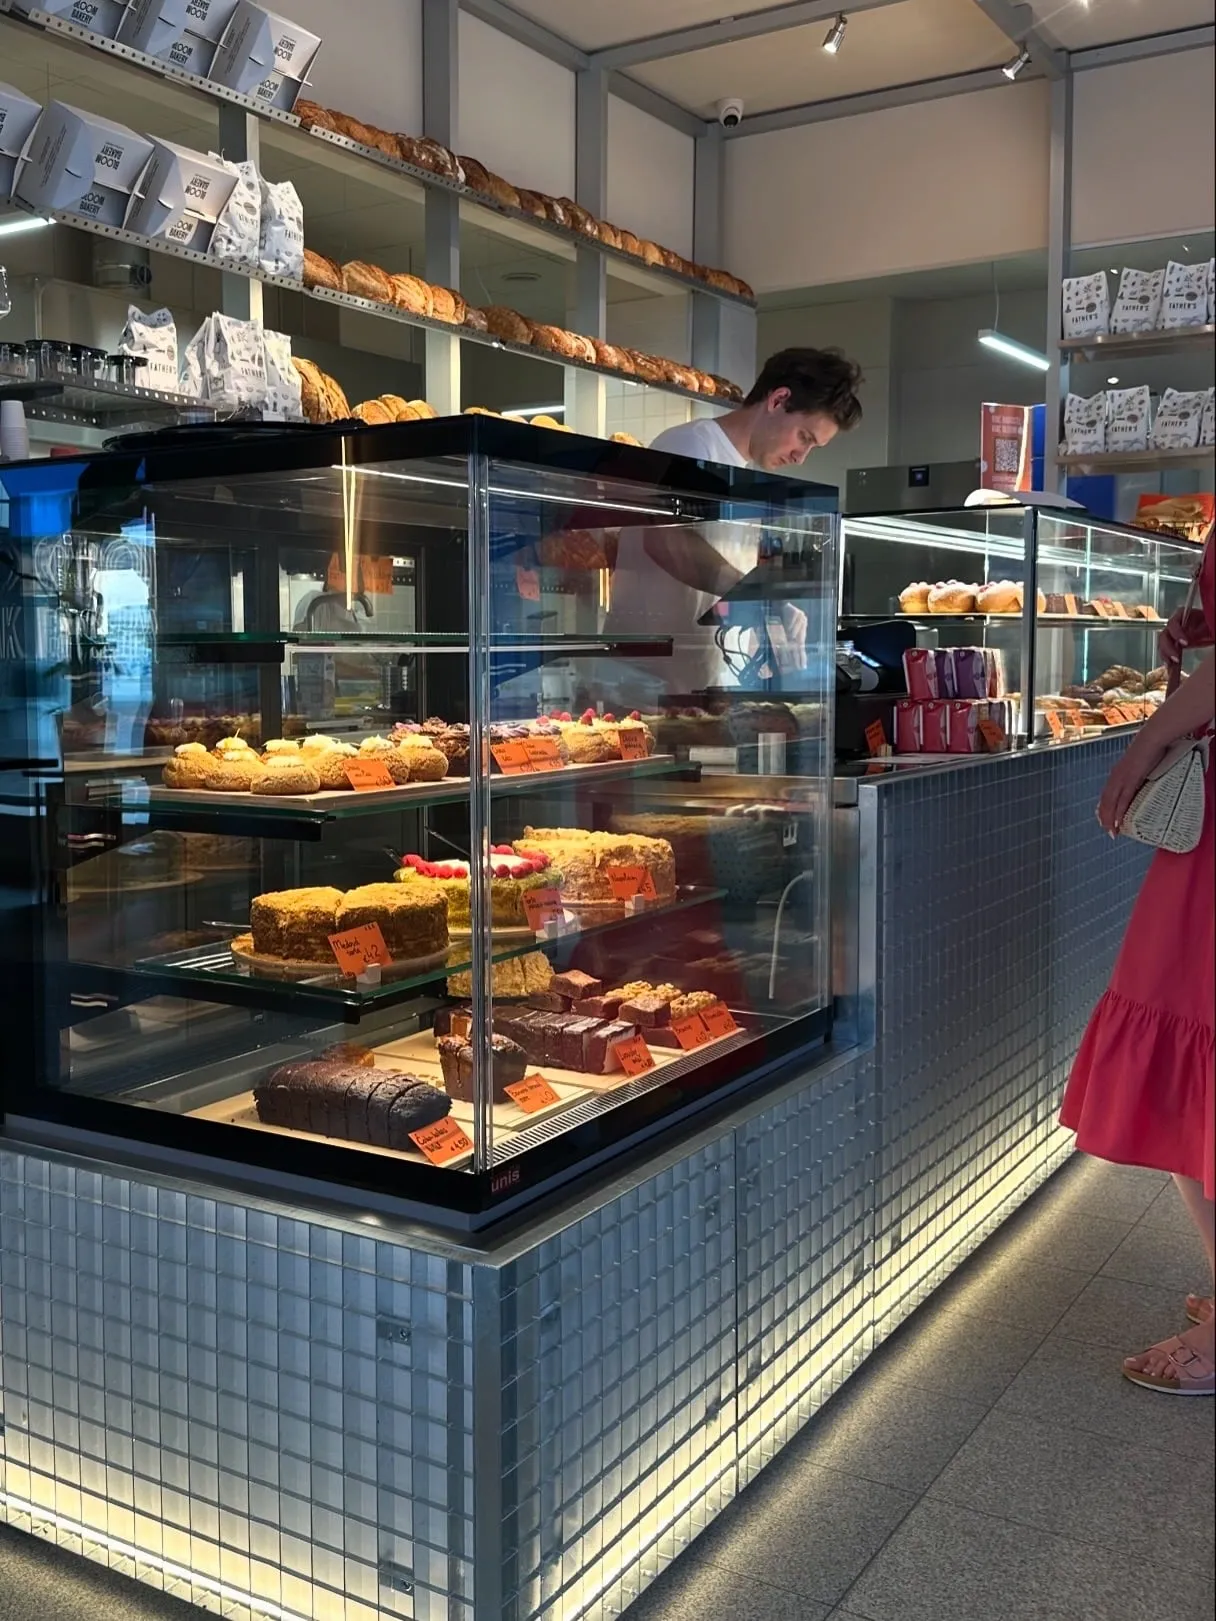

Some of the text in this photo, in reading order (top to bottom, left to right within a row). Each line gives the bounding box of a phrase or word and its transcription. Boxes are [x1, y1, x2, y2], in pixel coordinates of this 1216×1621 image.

[71, 10, 93, 24] BAKERY
[169, 50, 188, 64] BAKERY
[101, 145, 123, 160] BAKERY
[95, 154, 120, 170] BLOOM
[190, 177, 210, 190] BAKERY
[184, 185, 207, 200] BLOOM
[79, 201, 101, 215] BAKERY
[169, 228, 188, 240] BAKERY
[1072, 313, 1098, 324] FATHER'S
[150, 362, 177, 375] FATHER'S
[491, 1169, 520, 1192] unis
